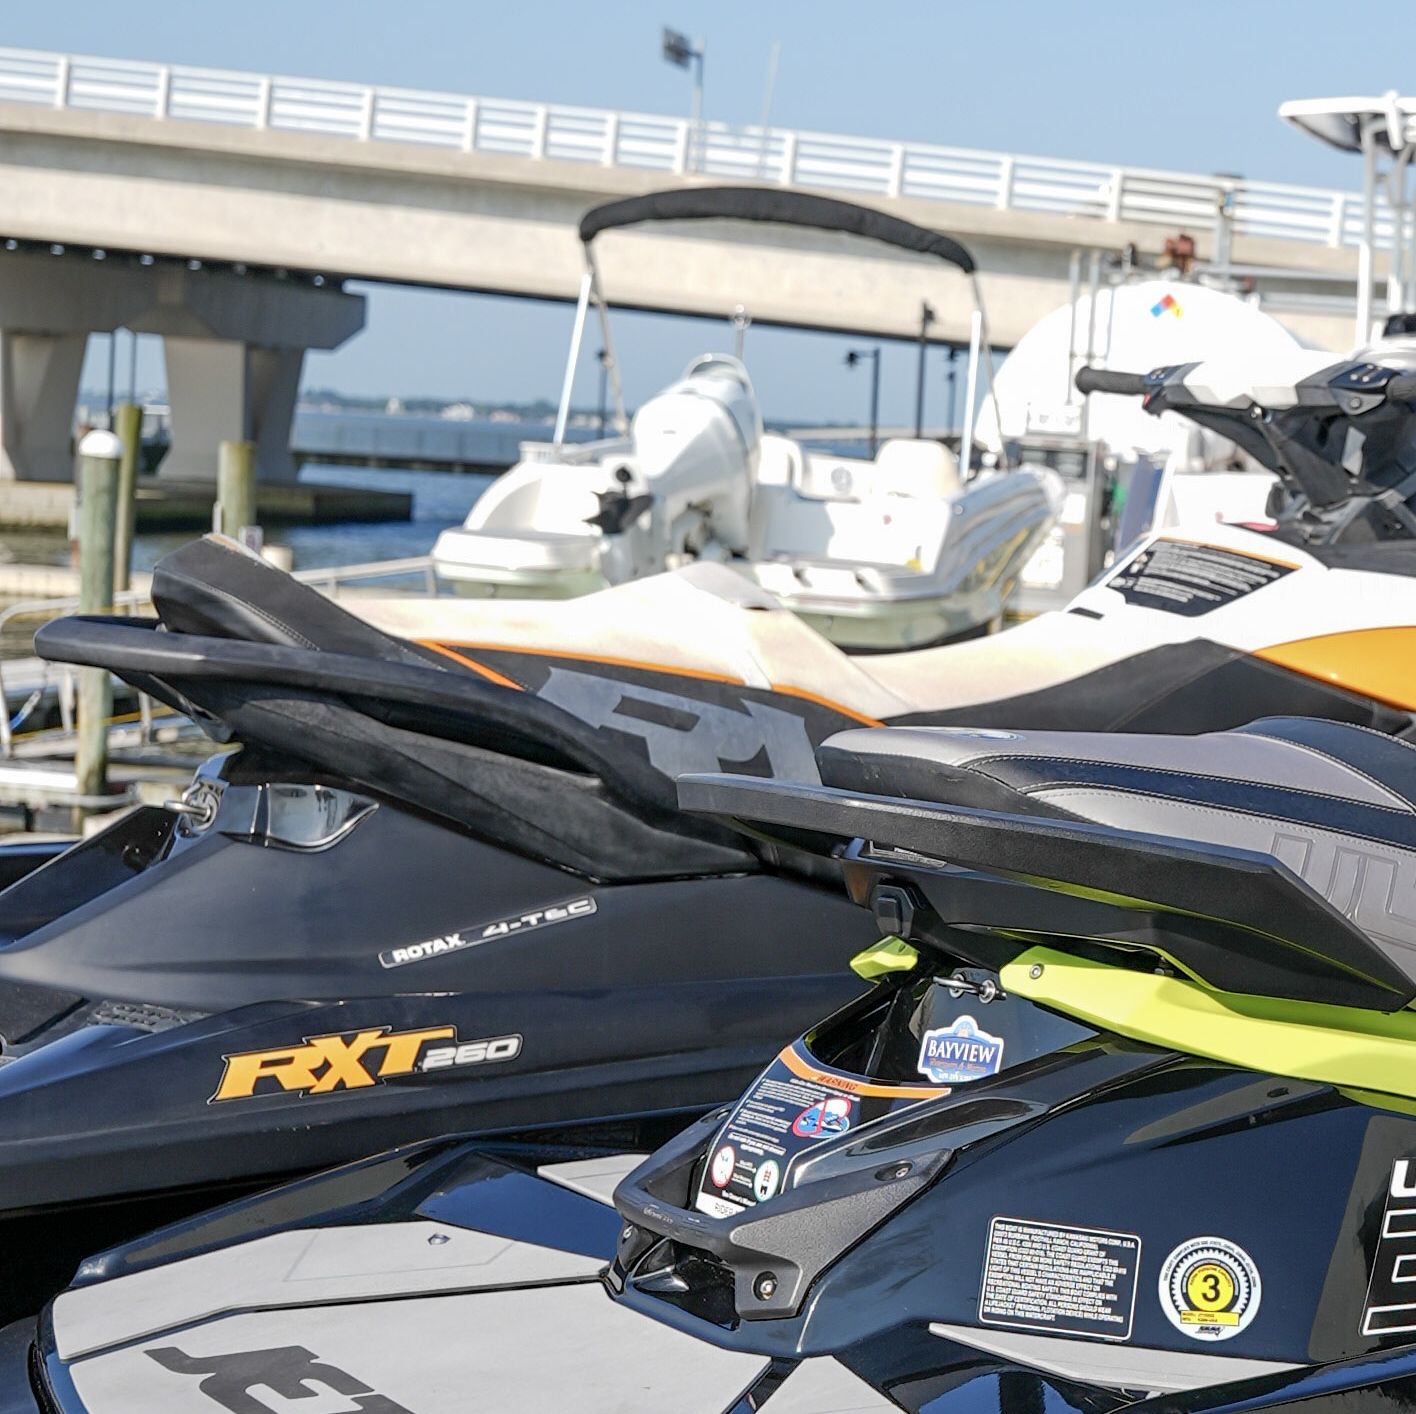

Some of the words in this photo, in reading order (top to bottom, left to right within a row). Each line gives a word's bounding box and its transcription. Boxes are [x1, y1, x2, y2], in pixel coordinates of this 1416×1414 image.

[392, 933, 465, 963] ROTAX
[216, 1028, 453, 1100] RXT
[422, 1038, 519, 1071] 260
[928, 1040, 995, 1063] BAYVIEW
[1202, 1274, 1220, 1302] 3
